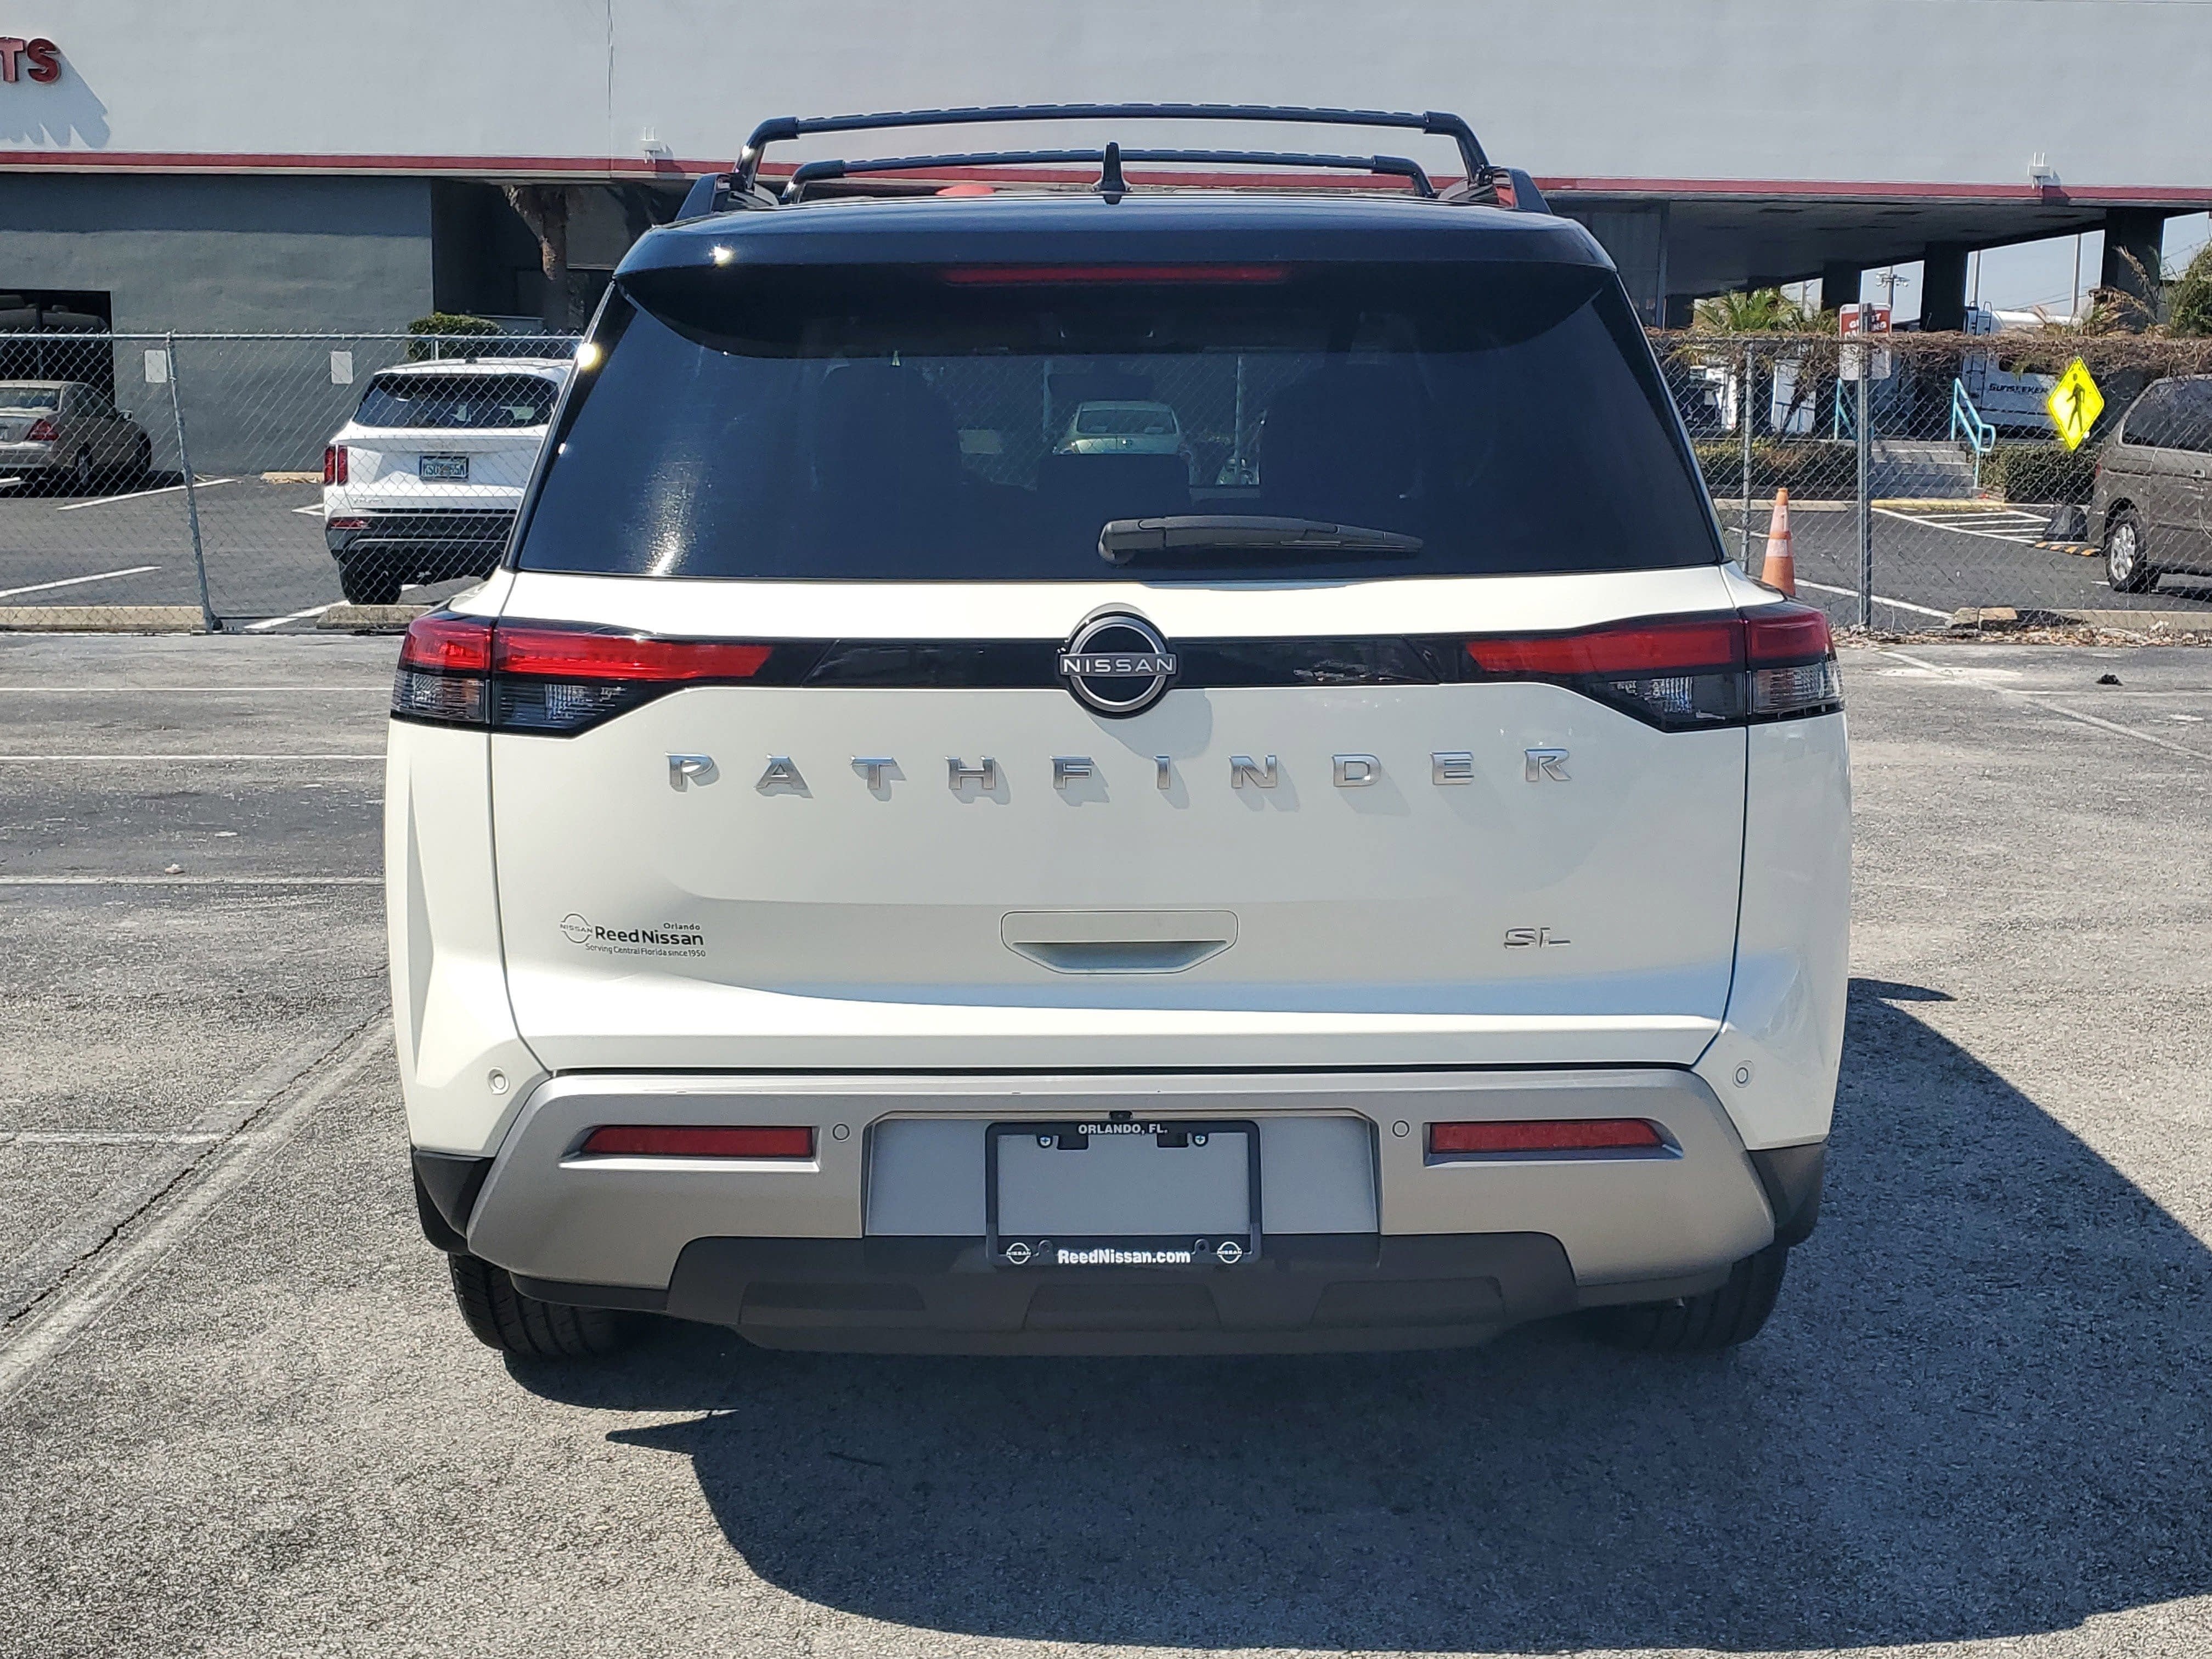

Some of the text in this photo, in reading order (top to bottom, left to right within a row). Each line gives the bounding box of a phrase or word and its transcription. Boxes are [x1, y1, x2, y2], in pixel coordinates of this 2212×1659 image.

[1063, 658, 1173, 673] NISSAN
[665, 748, 1572, 791] PATHFINDER
[560, 923, 593, 933] NISSAN
[663, 922, 701, 930] Orlando
[1504, 927, 1571, 949] SL
[585, 943, 613, 954] Serving
[614, 945, 640, 955] Central
[641, 947, 667, 956] Florida
[688, 949, 706, 957] 1950
[1078, 1123, 1169, 1135] ORLANDO, FL.
[1058, 1249, 1191, 1265] ReedNissan.com
